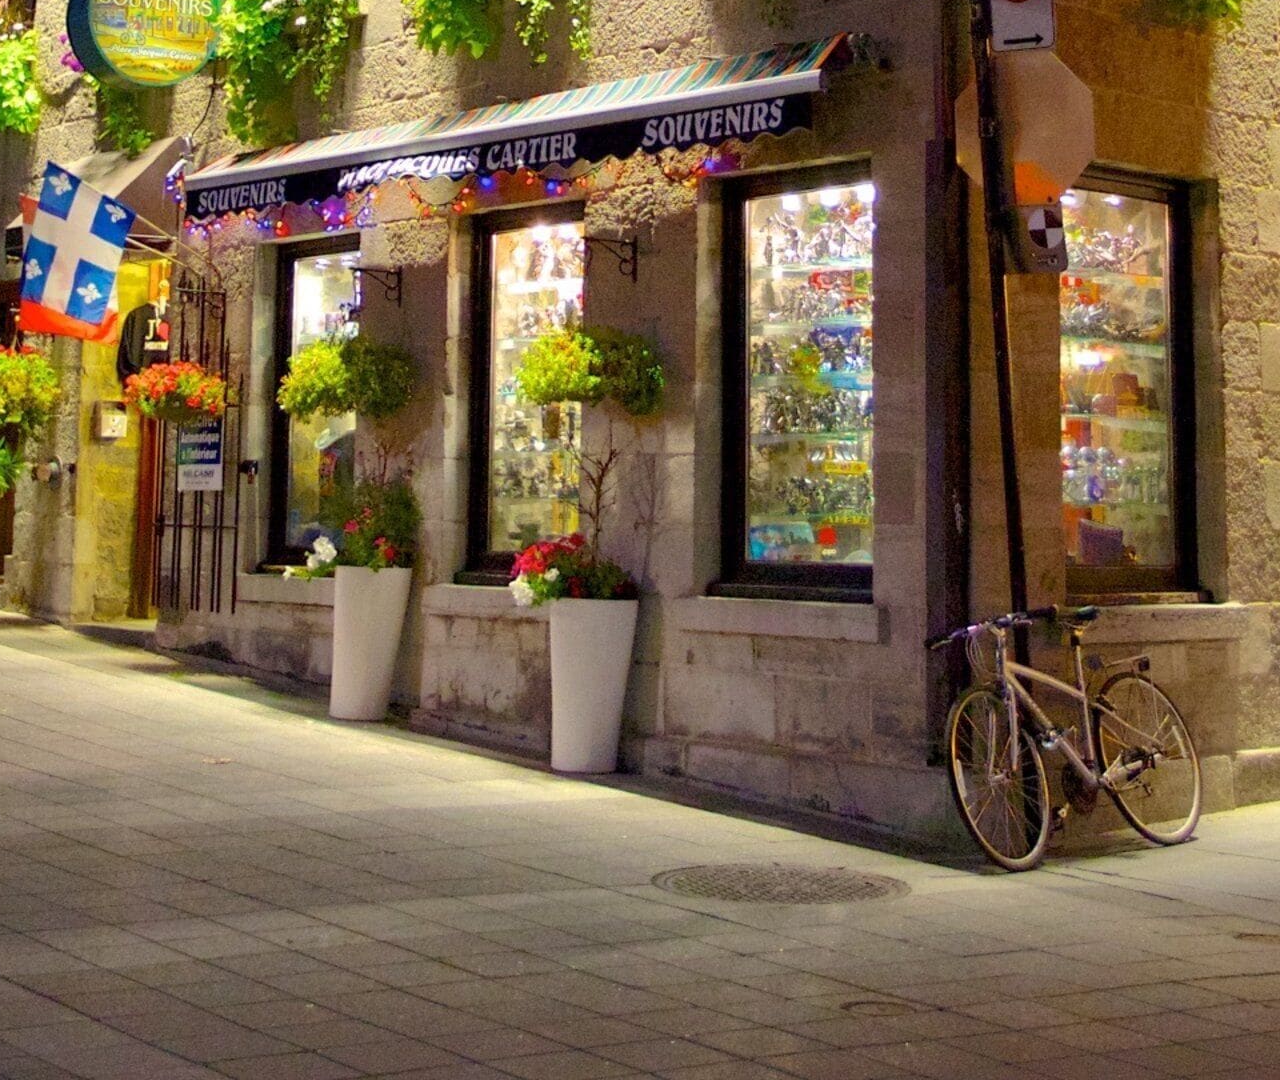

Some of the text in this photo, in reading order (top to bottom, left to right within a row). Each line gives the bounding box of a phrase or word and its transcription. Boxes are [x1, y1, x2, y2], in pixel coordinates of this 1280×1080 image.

[197, 178, 288, 214] SOUVENIRS
[486, 132, 577, 171] CARTIER
[641, 98, 785, 147] SOUVENIRS
